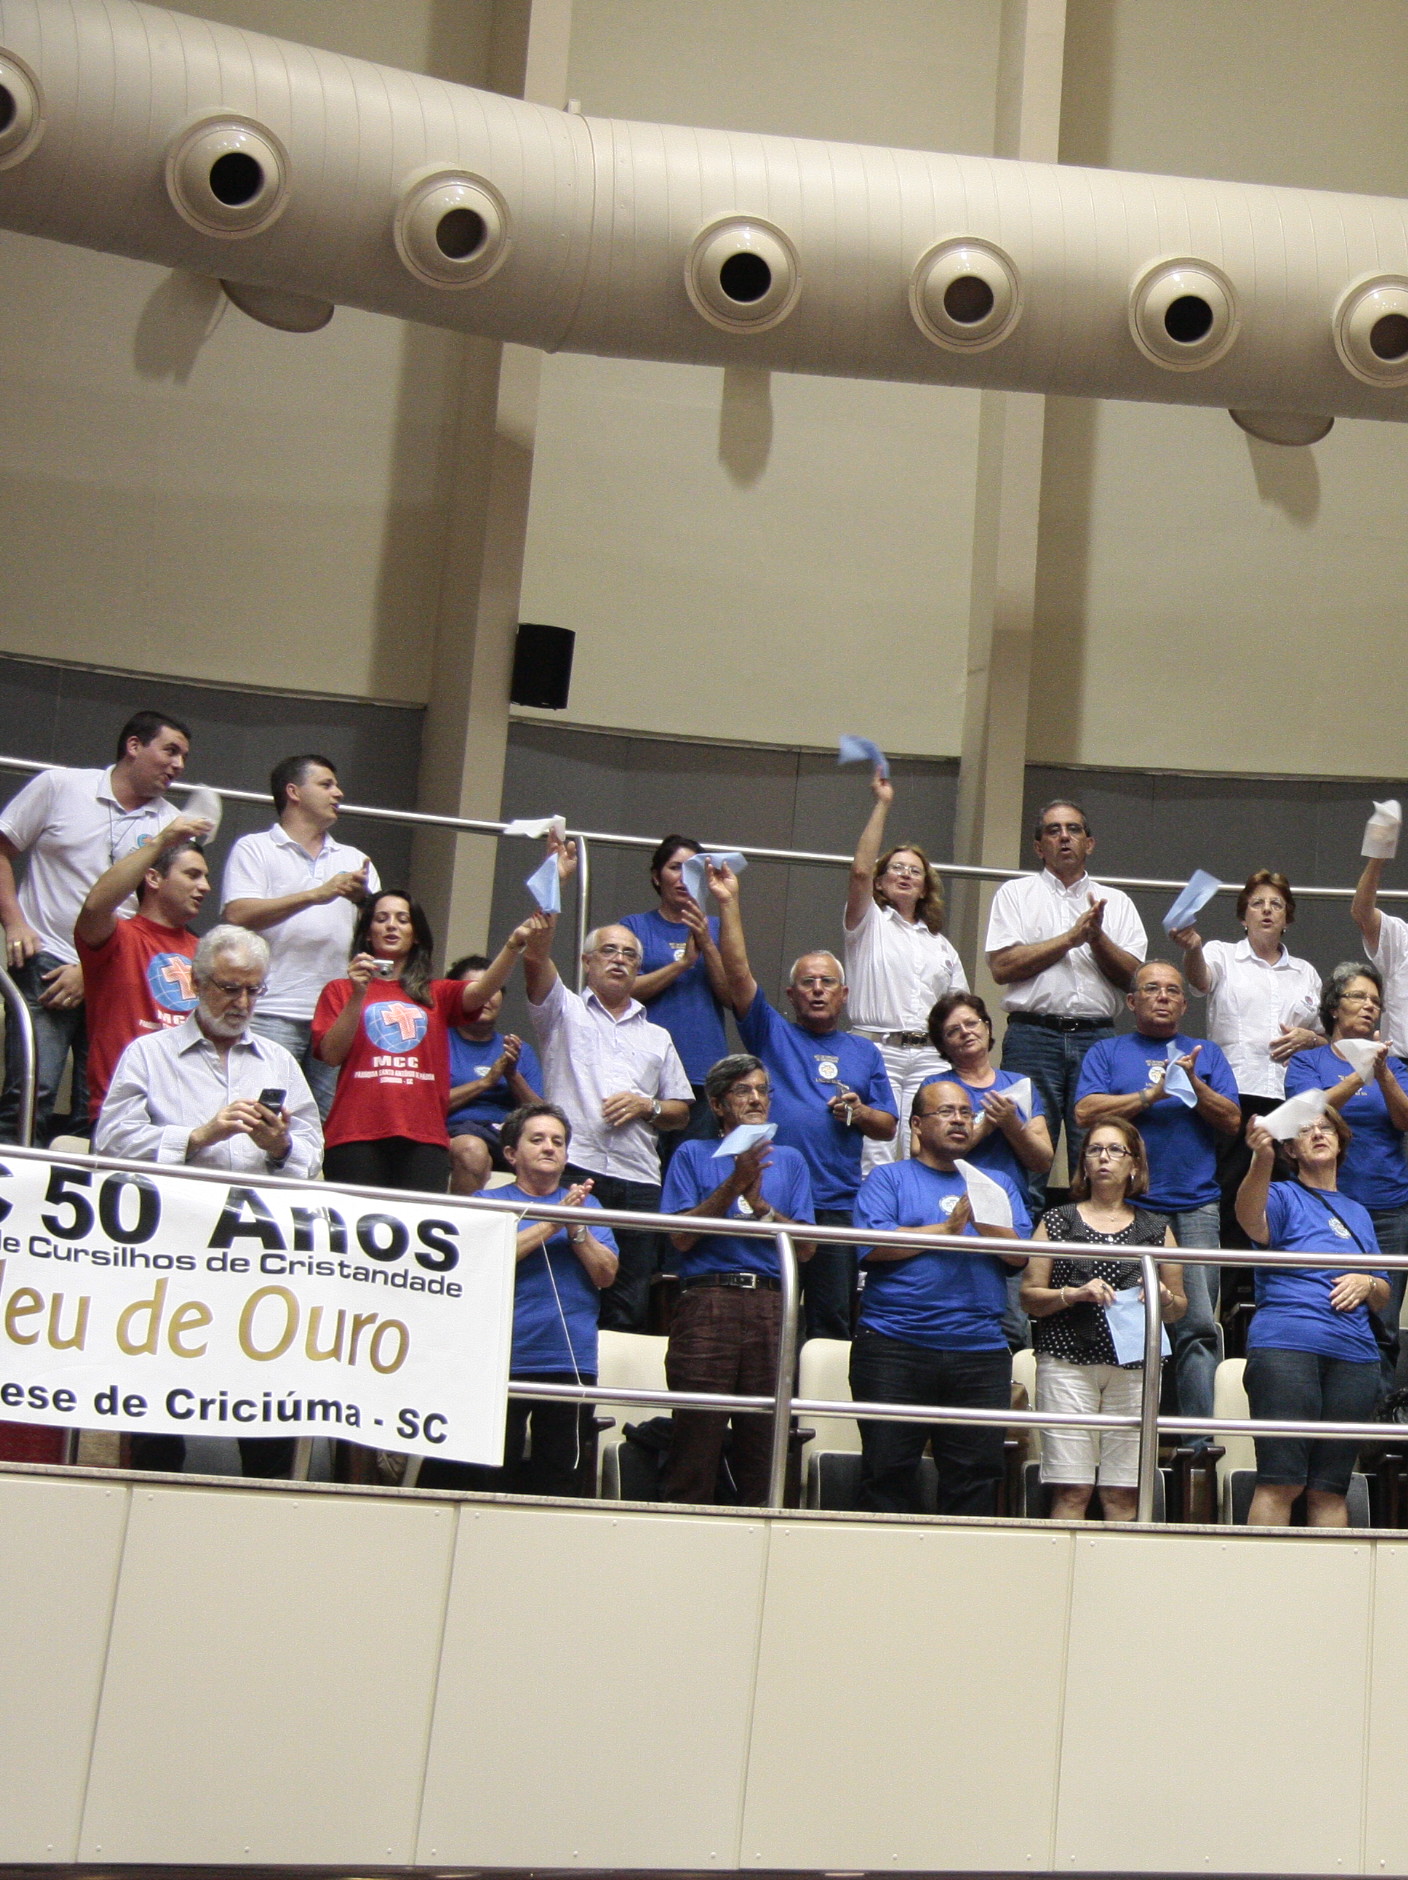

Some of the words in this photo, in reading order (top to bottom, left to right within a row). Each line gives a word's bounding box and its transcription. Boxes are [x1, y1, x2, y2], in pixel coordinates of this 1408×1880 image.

[158, 1010, 187, 1025] MC
[373, 1055, 418, 1068] MCC
[41, 1165, 162, 1245] 50
[207, 1186, 461, 1273] Anos
[0, 1229, 21, 1253] e
[28, 1235, 197, 1271] Cursilhos
[206, 1251, 250, 1273] de
[260, 1253, 463, 1298] Cristandade
[116, 1276, 214, 1359] de
[238, 1284, 410, 1375] Ouro
[94, 1384, 148, 1418] de
[165, 1388, 361, 1429] Criciúma
[396, 1407, 449, 1444] SC
